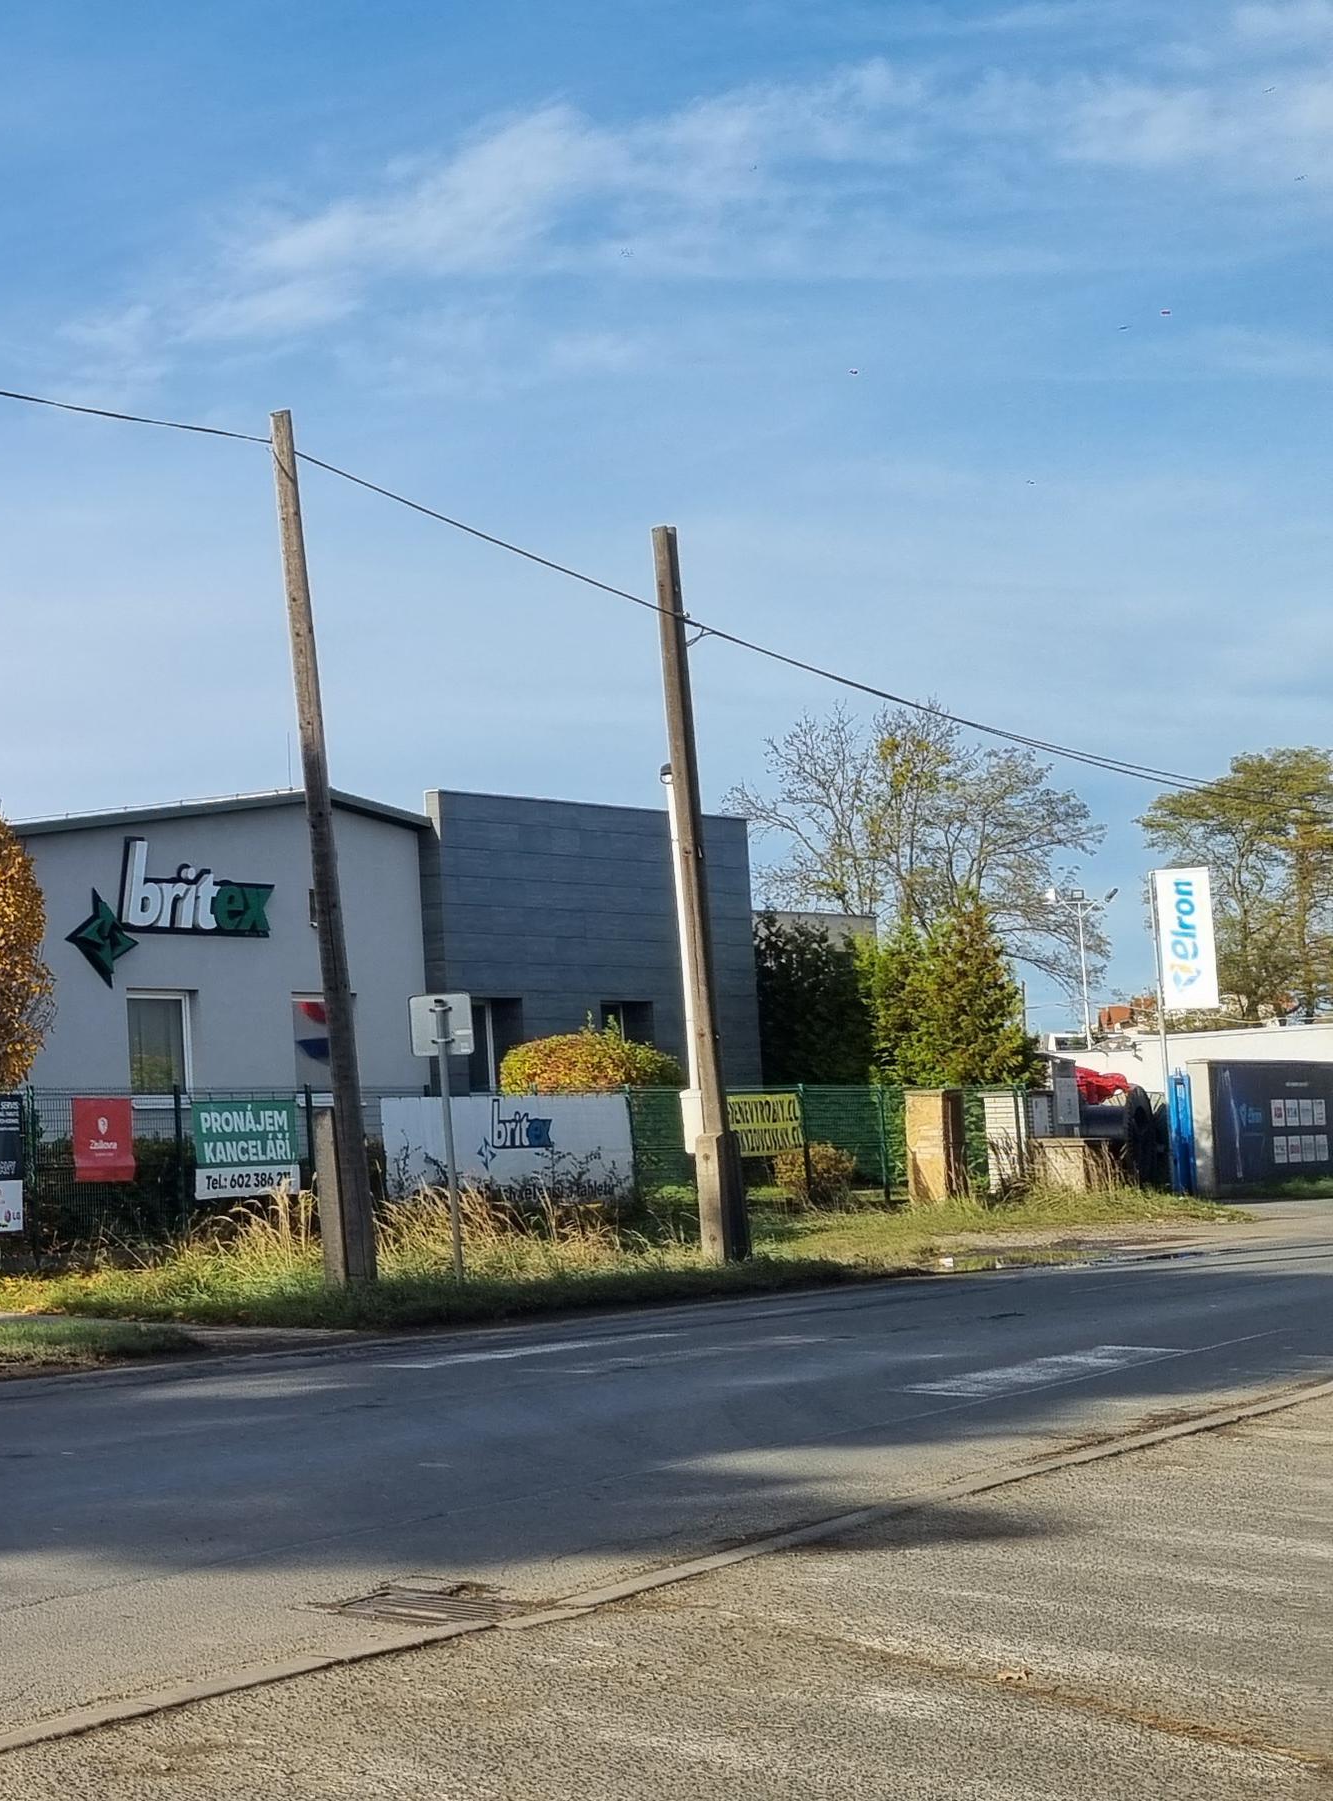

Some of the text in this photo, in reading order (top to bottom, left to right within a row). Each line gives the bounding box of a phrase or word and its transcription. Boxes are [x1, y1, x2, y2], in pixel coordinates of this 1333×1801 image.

[120, 838, 275, 931] britex
[1170, 879, 1199, 960] elron
[199, 1103, 289, 1134] PRONÁJEM
[491, 1098, 553, 1149] britex
[203, 1132, 292, 1164] KANCELÁŘÍ
[206, 1174, 228, 1190] Tel.:
[230, 1173, 251, 1189] 602
[254, 1172, 274, 1188] 386
